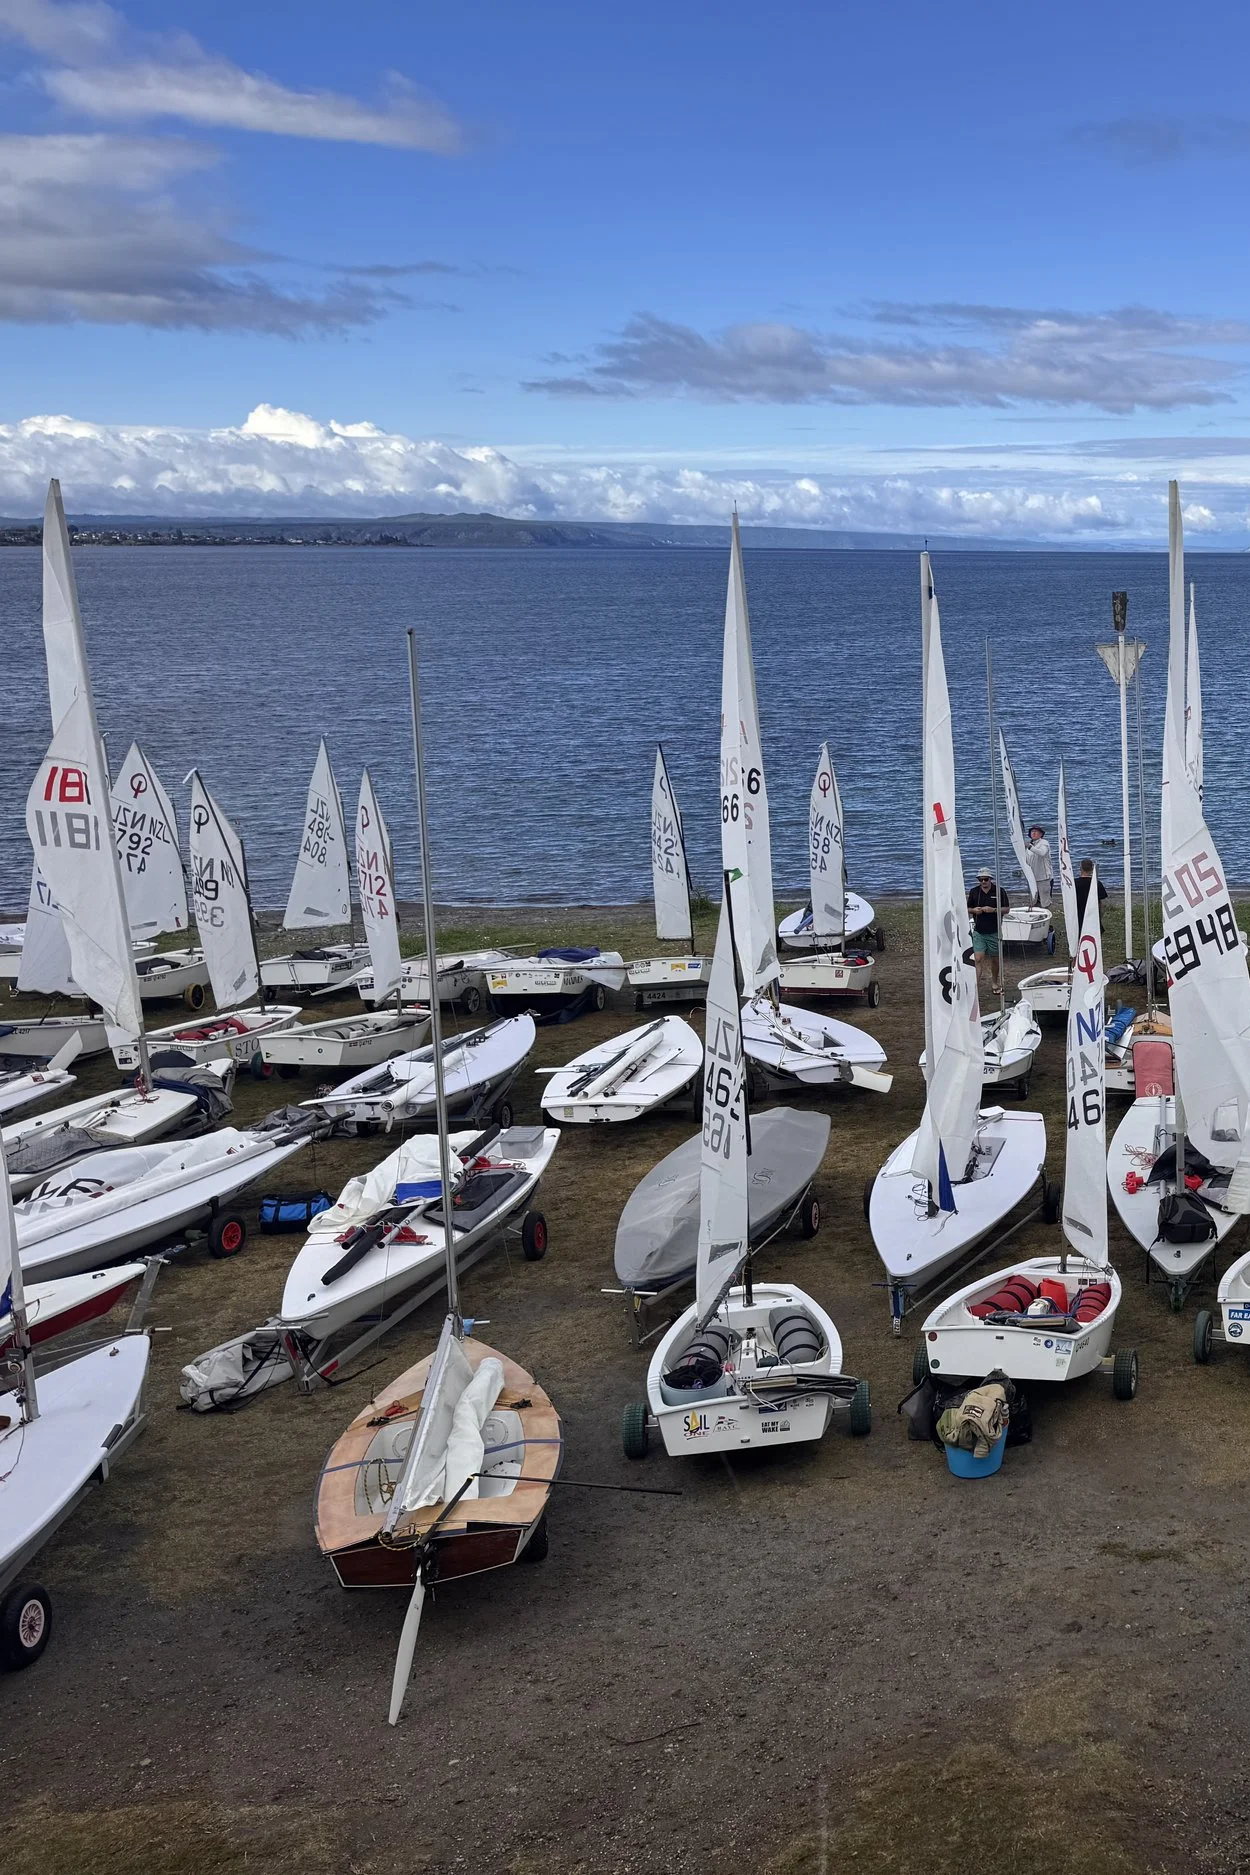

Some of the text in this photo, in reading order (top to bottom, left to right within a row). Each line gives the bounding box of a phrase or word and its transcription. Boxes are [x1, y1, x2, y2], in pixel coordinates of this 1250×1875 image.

[149, 816, 170, 844] NZL
[646, 991, 666, 1000] 4424
[1230, 1311, 1243, 1319] FAR
